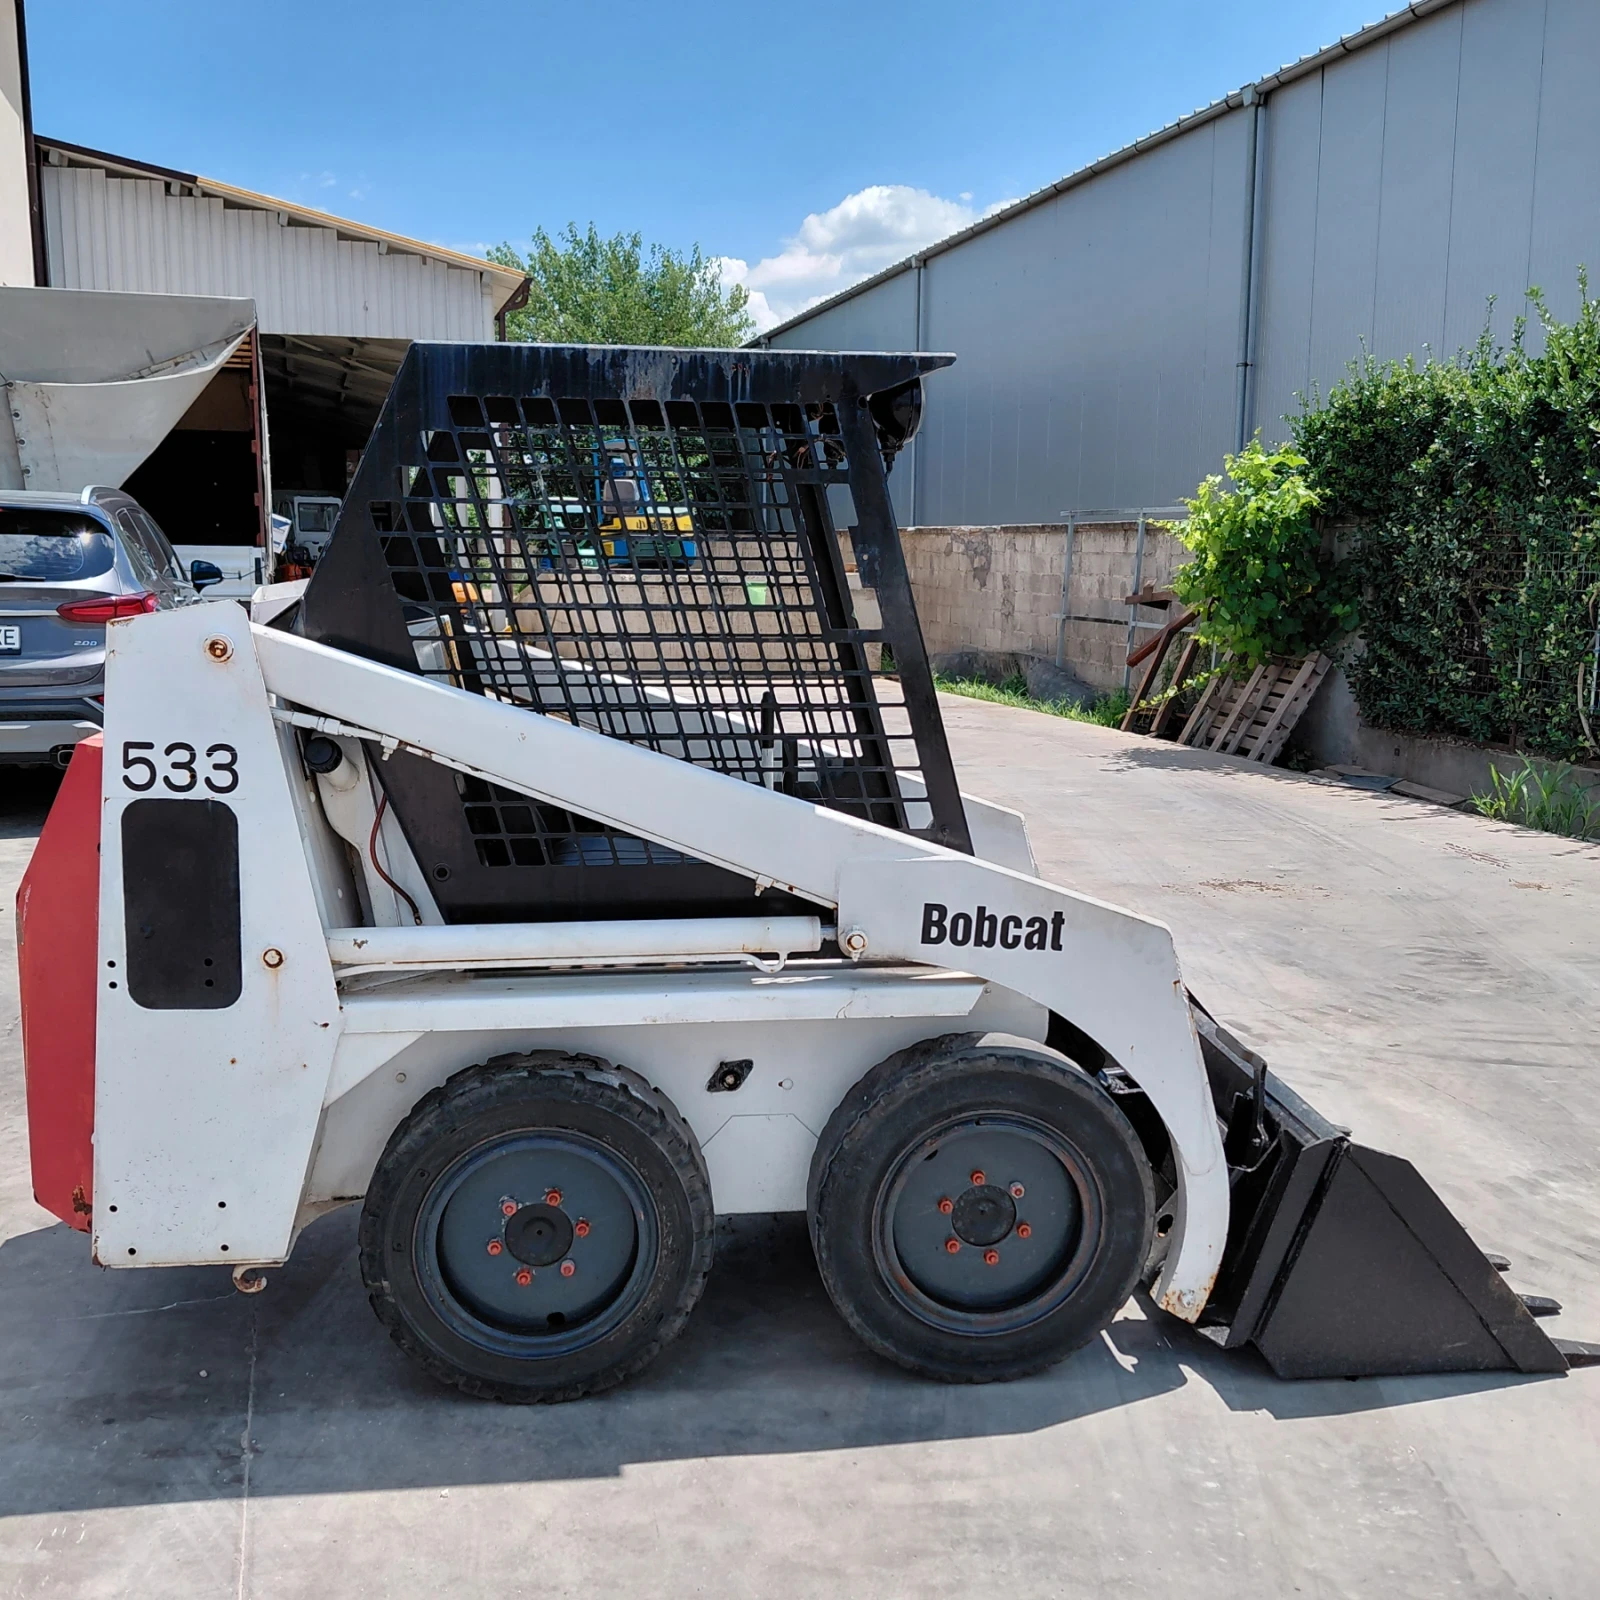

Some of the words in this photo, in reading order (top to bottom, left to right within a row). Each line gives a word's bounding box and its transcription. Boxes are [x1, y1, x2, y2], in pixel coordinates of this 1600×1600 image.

[0, 629, 15, 645] E
[122, 741, 239, 794] 533
[920, 903, 1065, 951] Bobcat
